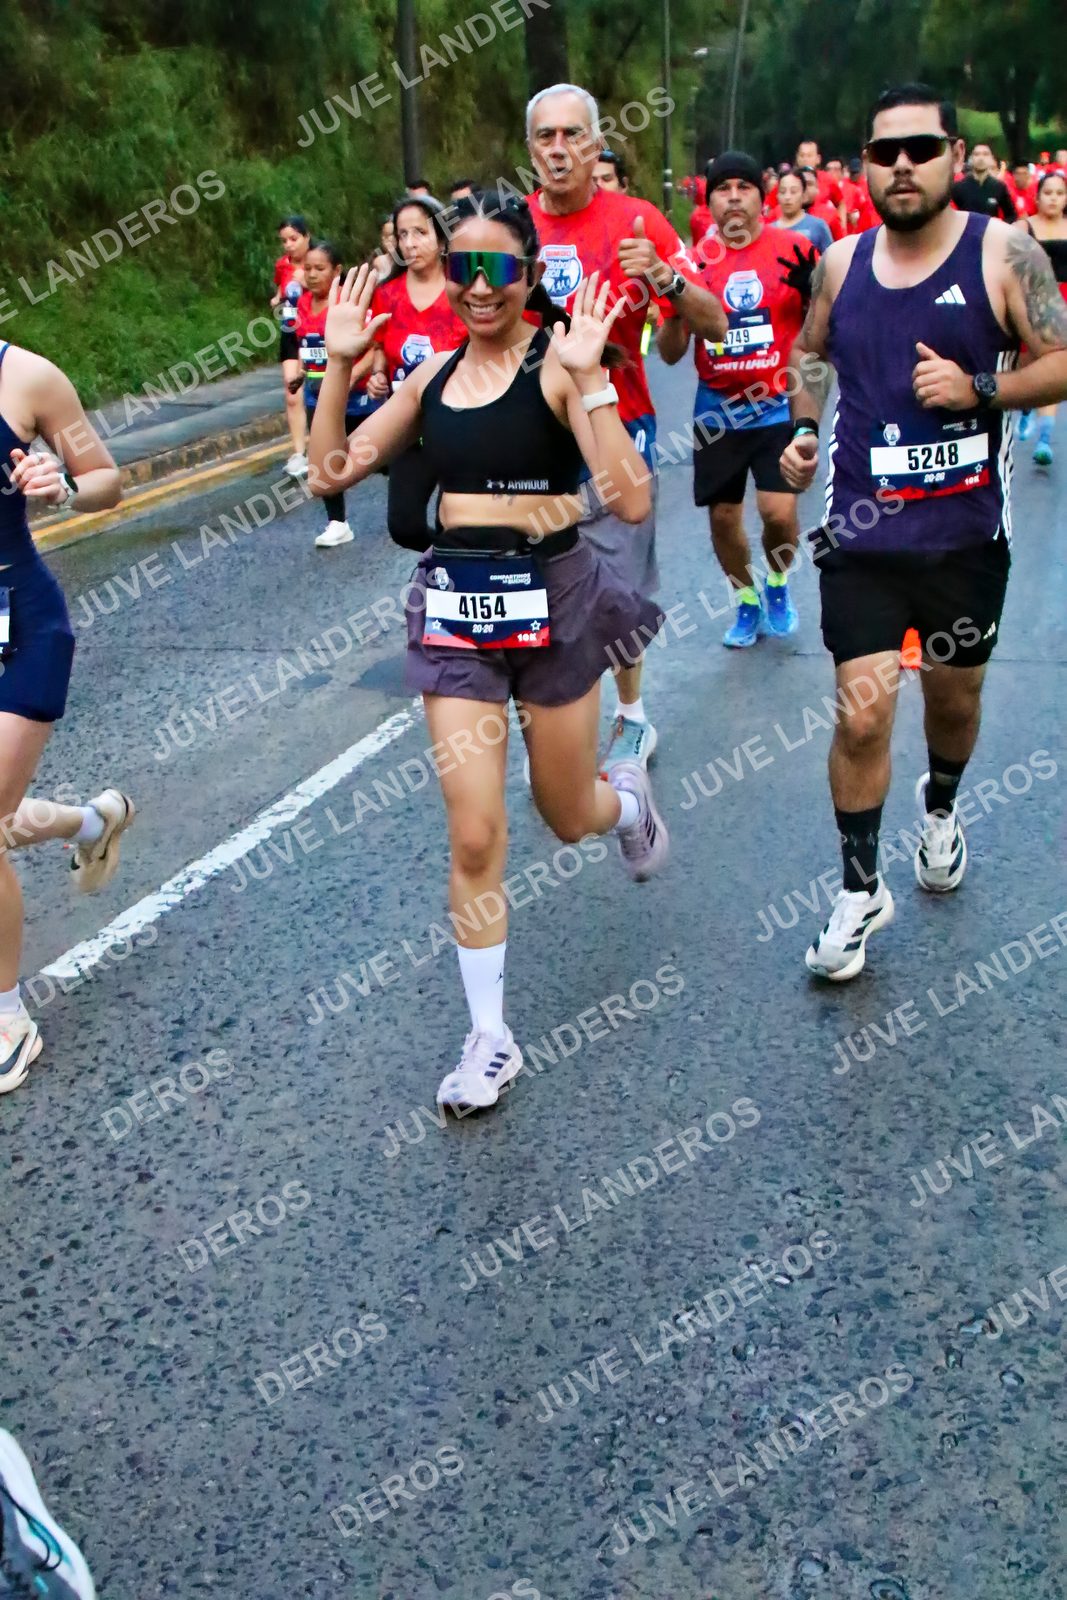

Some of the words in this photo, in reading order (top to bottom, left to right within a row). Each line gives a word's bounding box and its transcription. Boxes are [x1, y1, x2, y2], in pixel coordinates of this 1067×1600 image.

[907, 442, 959, 471] 5248
[459, 594, 507, 620] 4154
[517, 632, 538, 642] 10K
